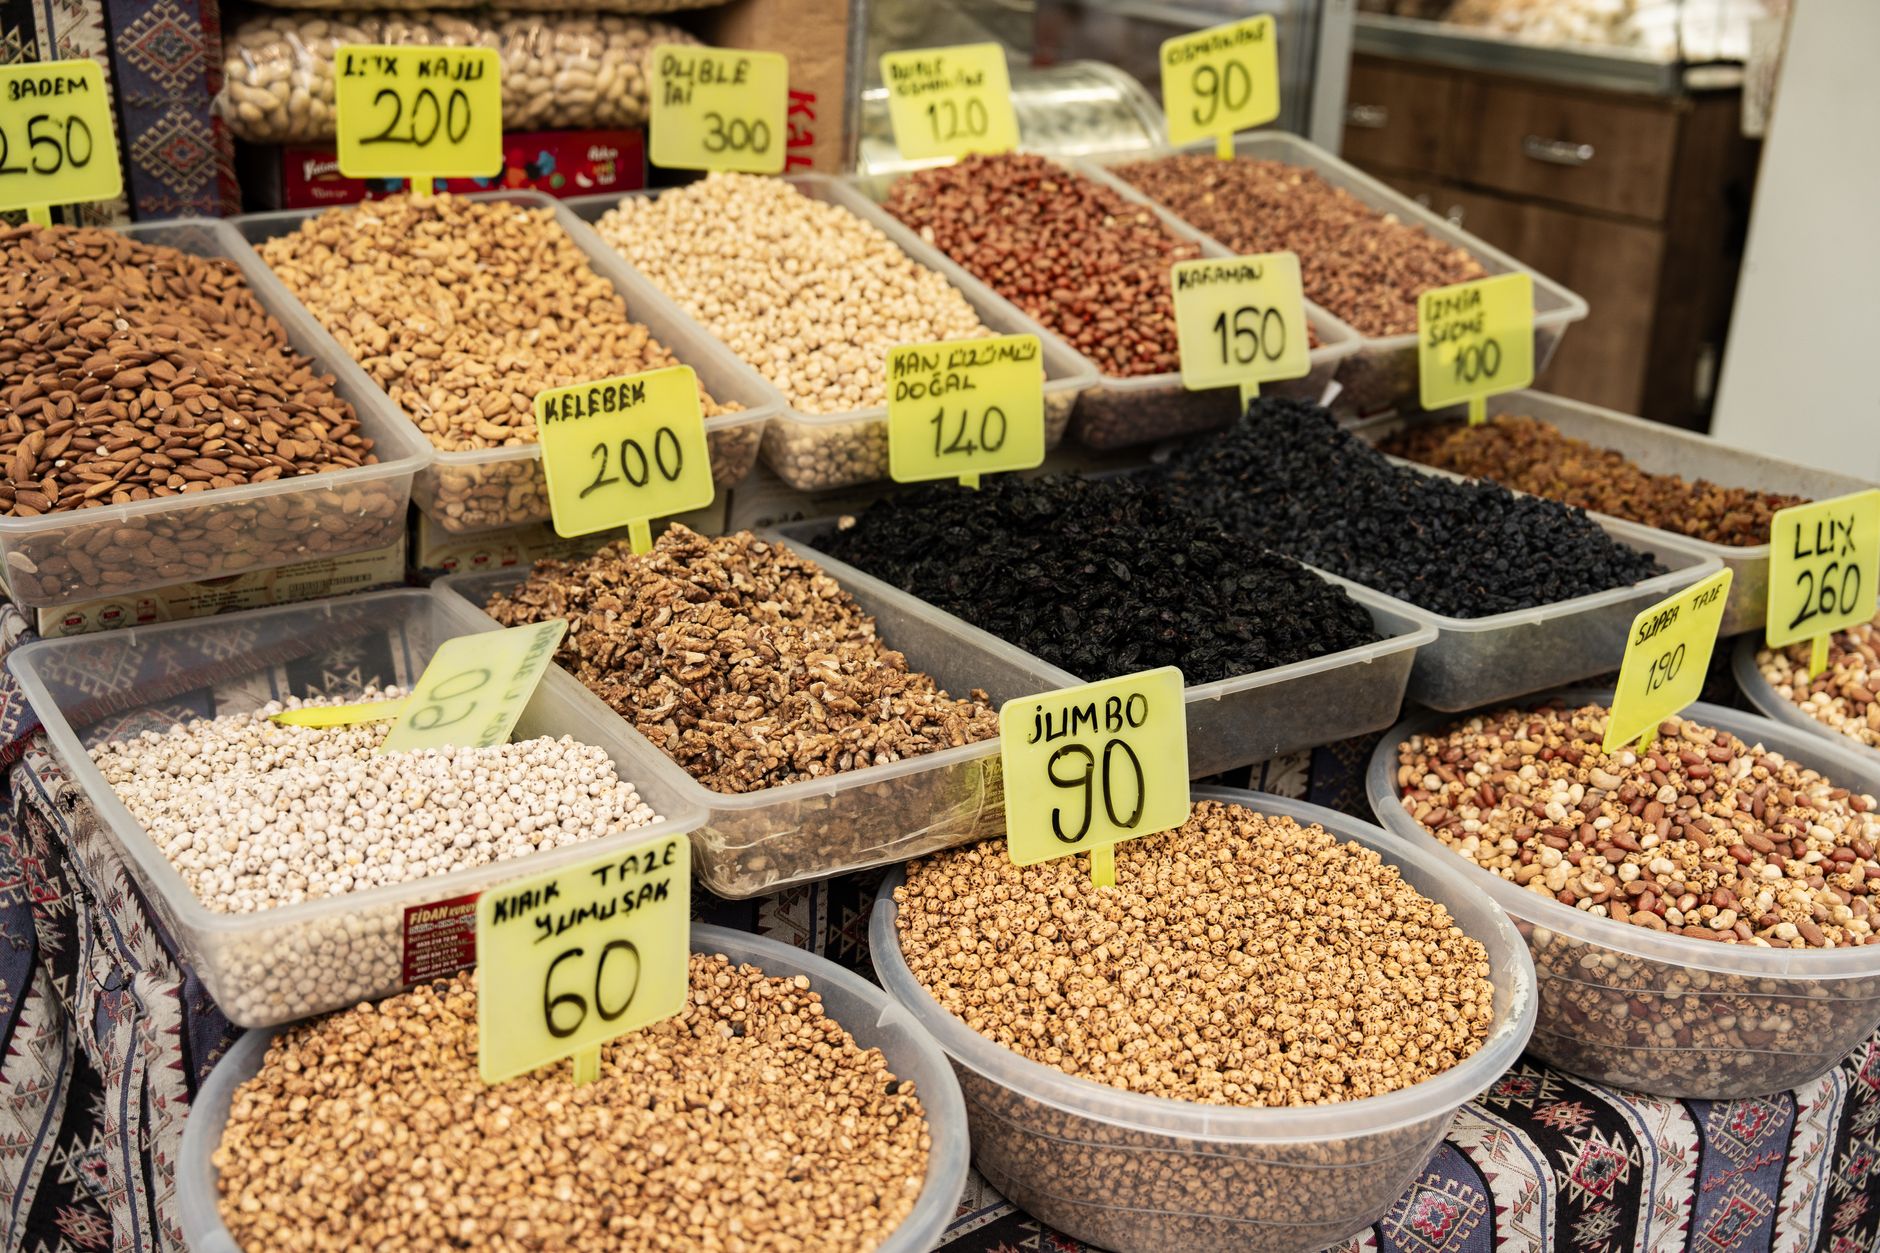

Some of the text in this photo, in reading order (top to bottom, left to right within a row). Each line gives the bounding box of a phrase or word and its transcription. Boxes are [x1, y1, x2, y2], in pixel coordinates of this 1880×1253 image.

[8, 76, 88, 101] BADEM
[1192, 60, 1252, 126] 90
[359, 88, 471, 147] 200
[703, 111, 771, 154] 300
[928, 98, 989, 142] 120
[1213, 306, 1287, 365] 150
[893, 351, 940, 379] KAN
[1454, 338, 1502, 383] 100
[545, 381, 645, 424] KELEBEK
[896, 371, 977, 402] DOĞAL
[930, 405, 1007, 458] 140
[579, 427, 683, 499] 200
[1692, 583, 1723, 611] TAZE
[1788, 561, 1861, 630] 260
[1646, 643, 1686, 696] 190
[1047, 738, 1146, 844] 90
[591, 841, 677, 887] TAZE
[410, 906, 449, 924] FİDAN
[543, 939, 641, 1039] 60
